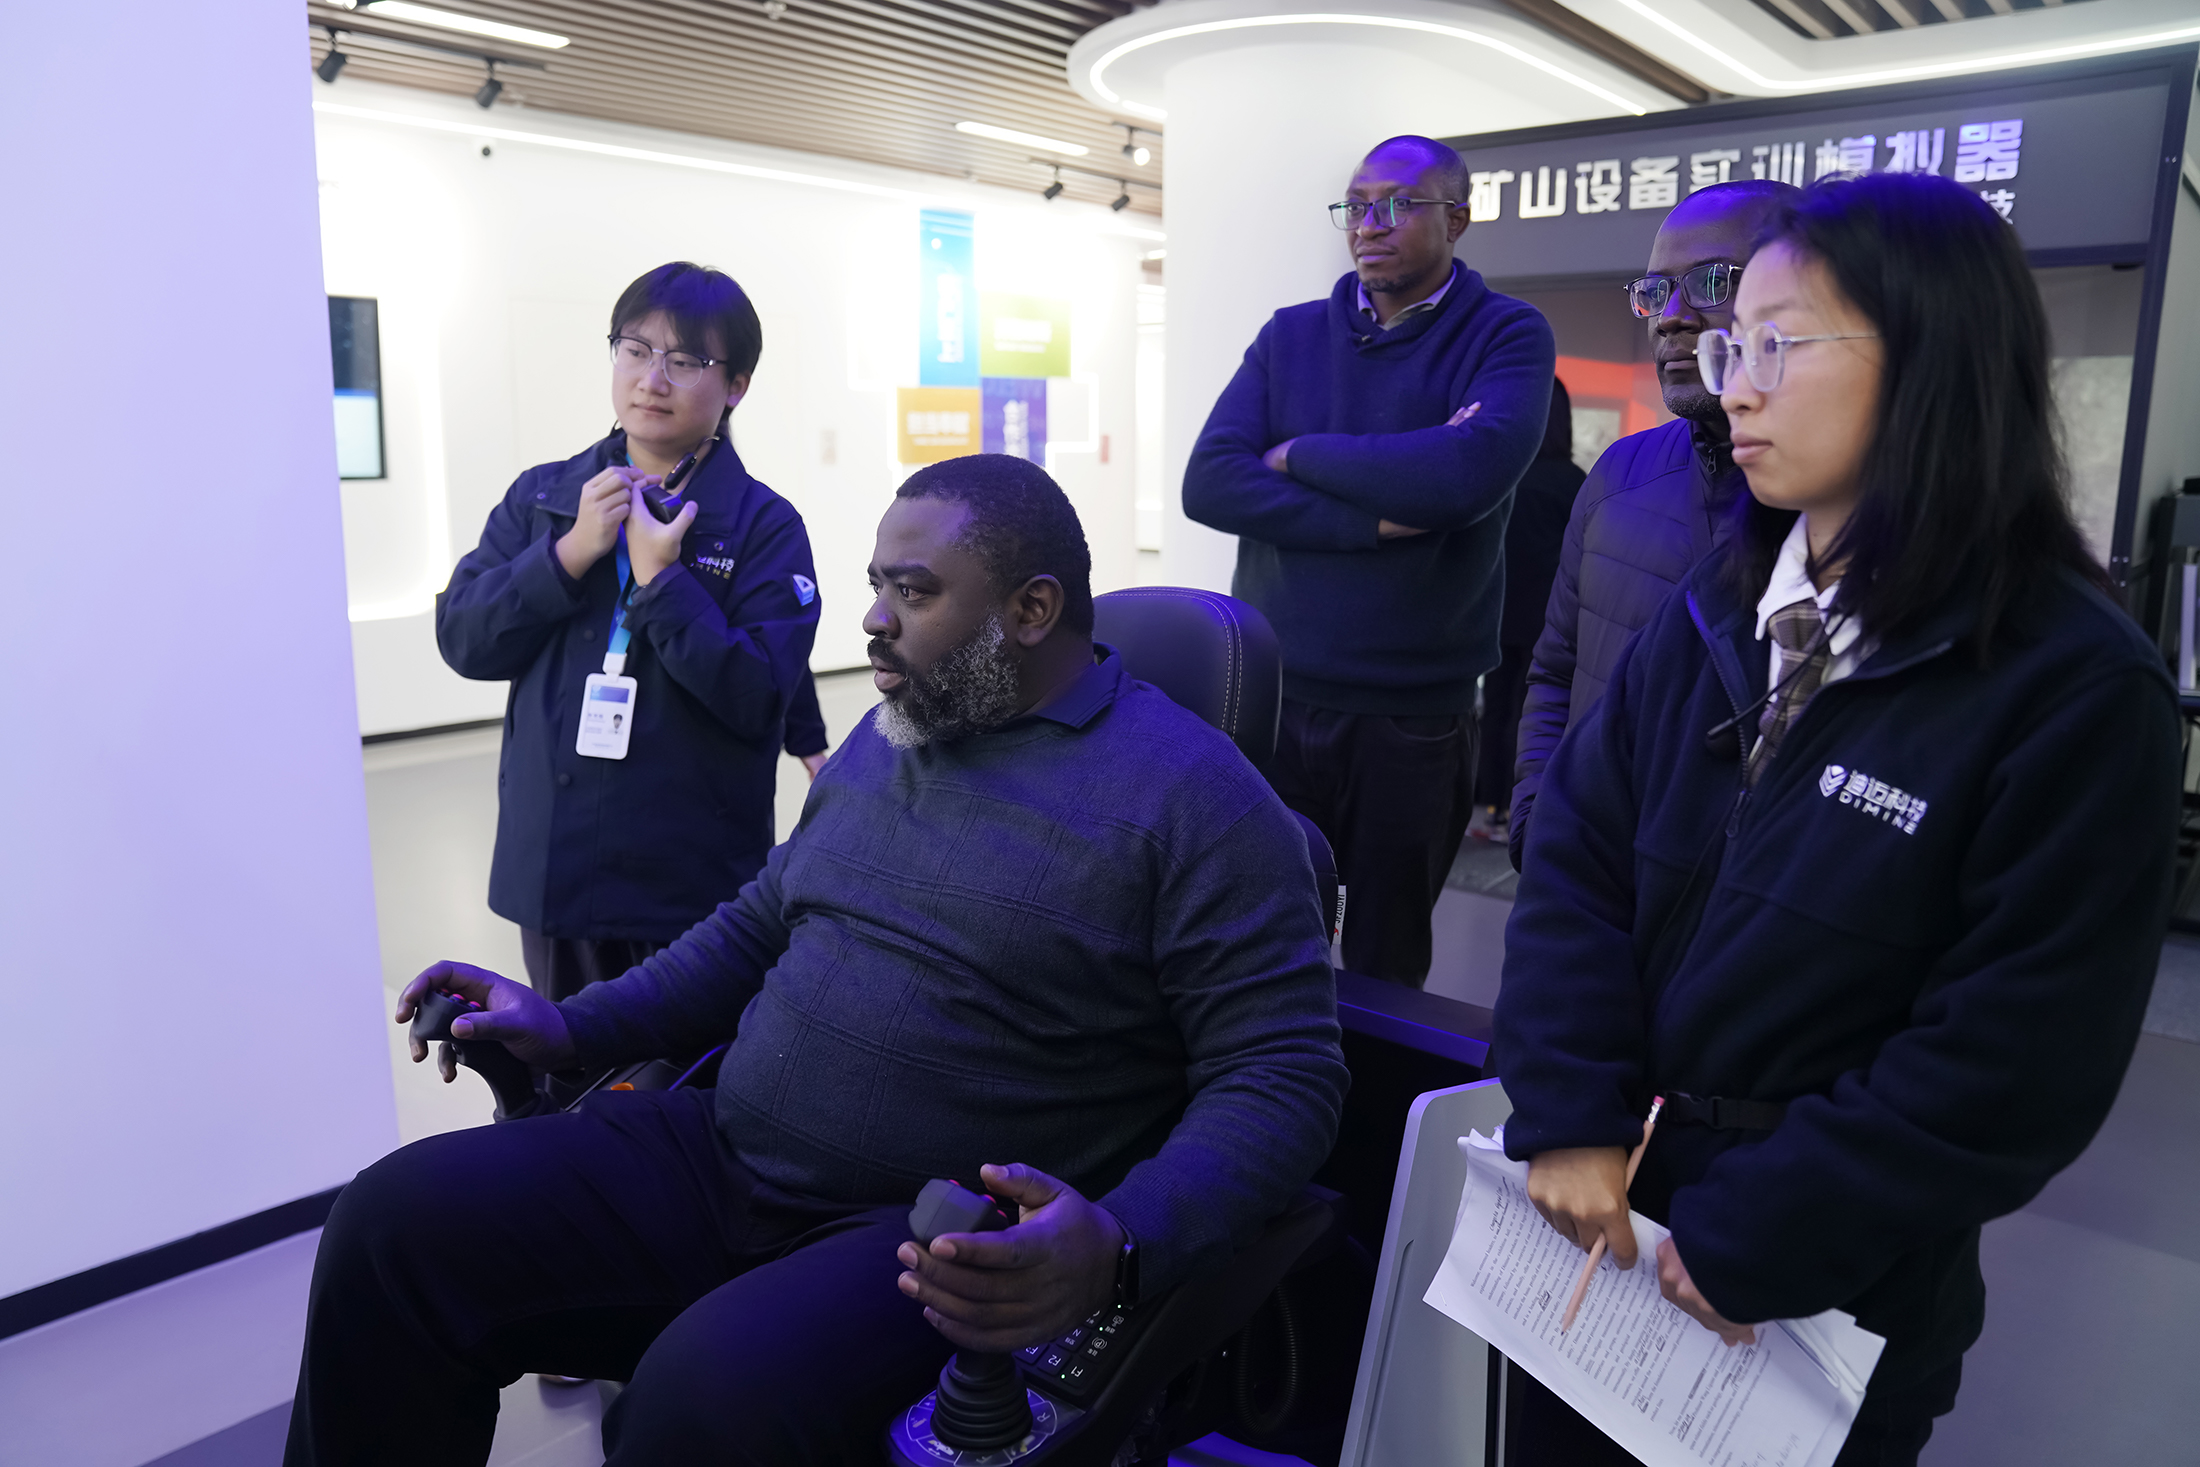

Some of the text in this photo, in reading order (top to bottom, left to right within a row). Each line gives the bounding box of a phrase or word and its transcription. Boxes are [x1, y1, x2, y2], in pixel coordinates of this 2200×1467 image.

[1838, 789, 1918, 836] DIMINE
[1047, 1354, 1062, 1366] F2
[1070, 1365, 1084, 1378] F1
